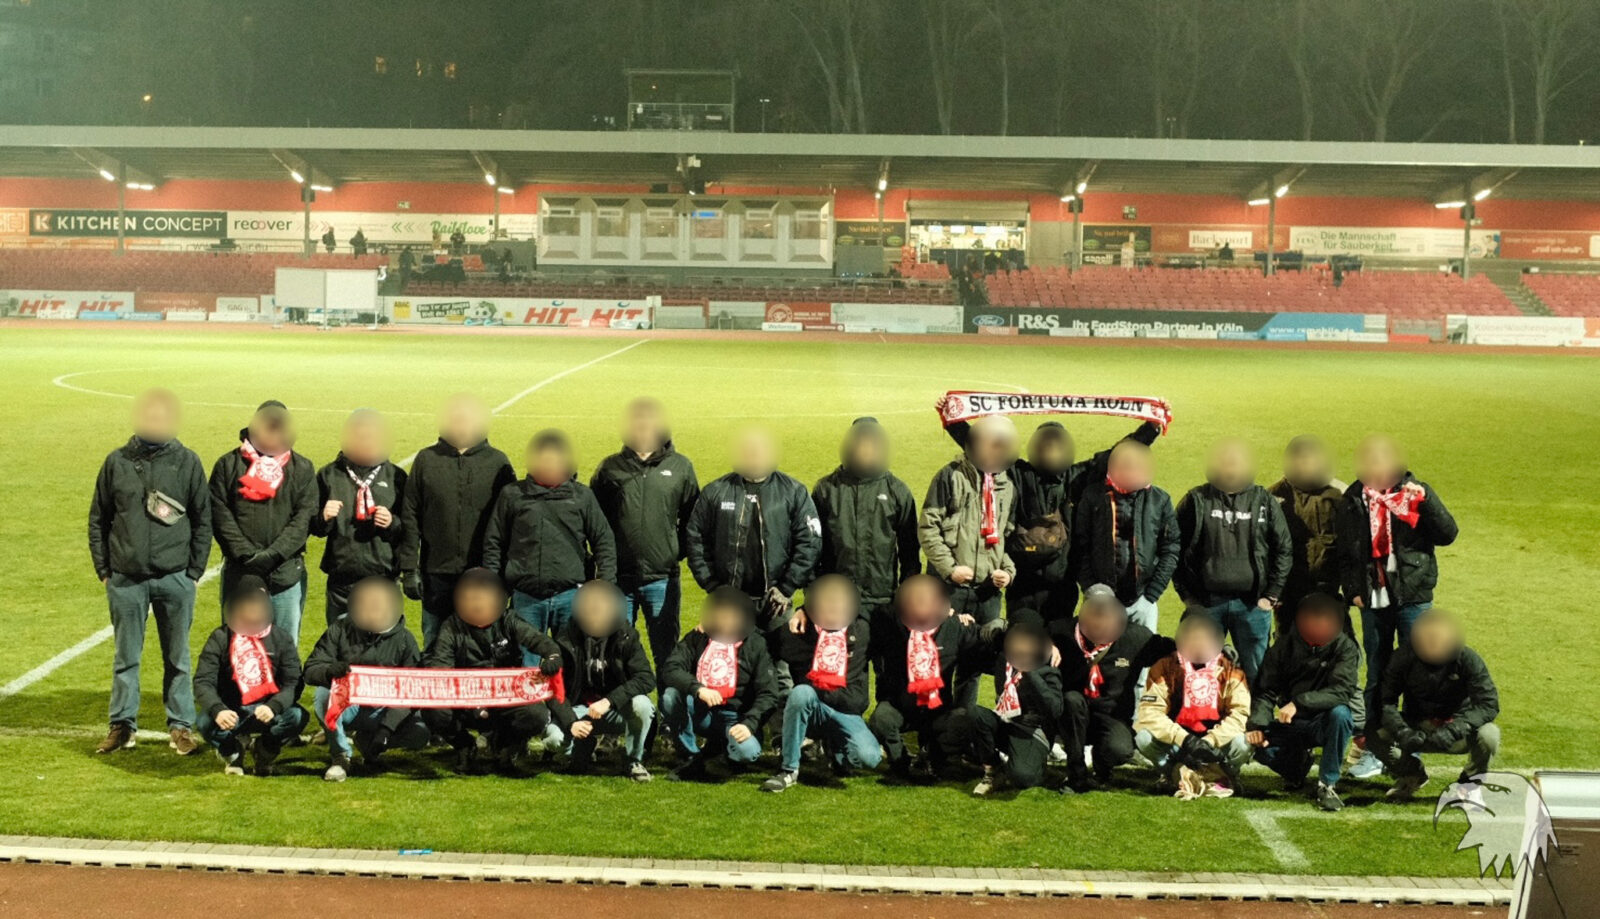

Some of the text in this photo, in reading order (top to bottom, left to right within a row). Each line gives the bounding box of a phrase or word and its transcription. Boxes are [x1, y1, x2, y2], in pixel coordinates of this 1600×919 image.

[57, 215, 223, 231] KITCHEN CONCEPT
[1320, 231, 1337, 241] Die
[1339, 231, 1397, 242] Mannschaft
[1323, 240, 1338, 250] für
[1339, 240, 1394, 251] Sauberkeit
[18, 299, 67, 314] HIT
[75, 300, 125, 314] HIT
[523, 307, 578, 324] HIT
[591, 308, 644, 322] HIT
[1018, 313, 1060, 329] R&S
[1072, 319, 1244, 332] Ihr FordStore Partner in Köln
[969, 395, 992, 413] SC
[998, 395, 1087, 411] FORTUNA
[357, 674, 397, 698] JAHRE
[398, 675, 457, 700] FORTUNA
